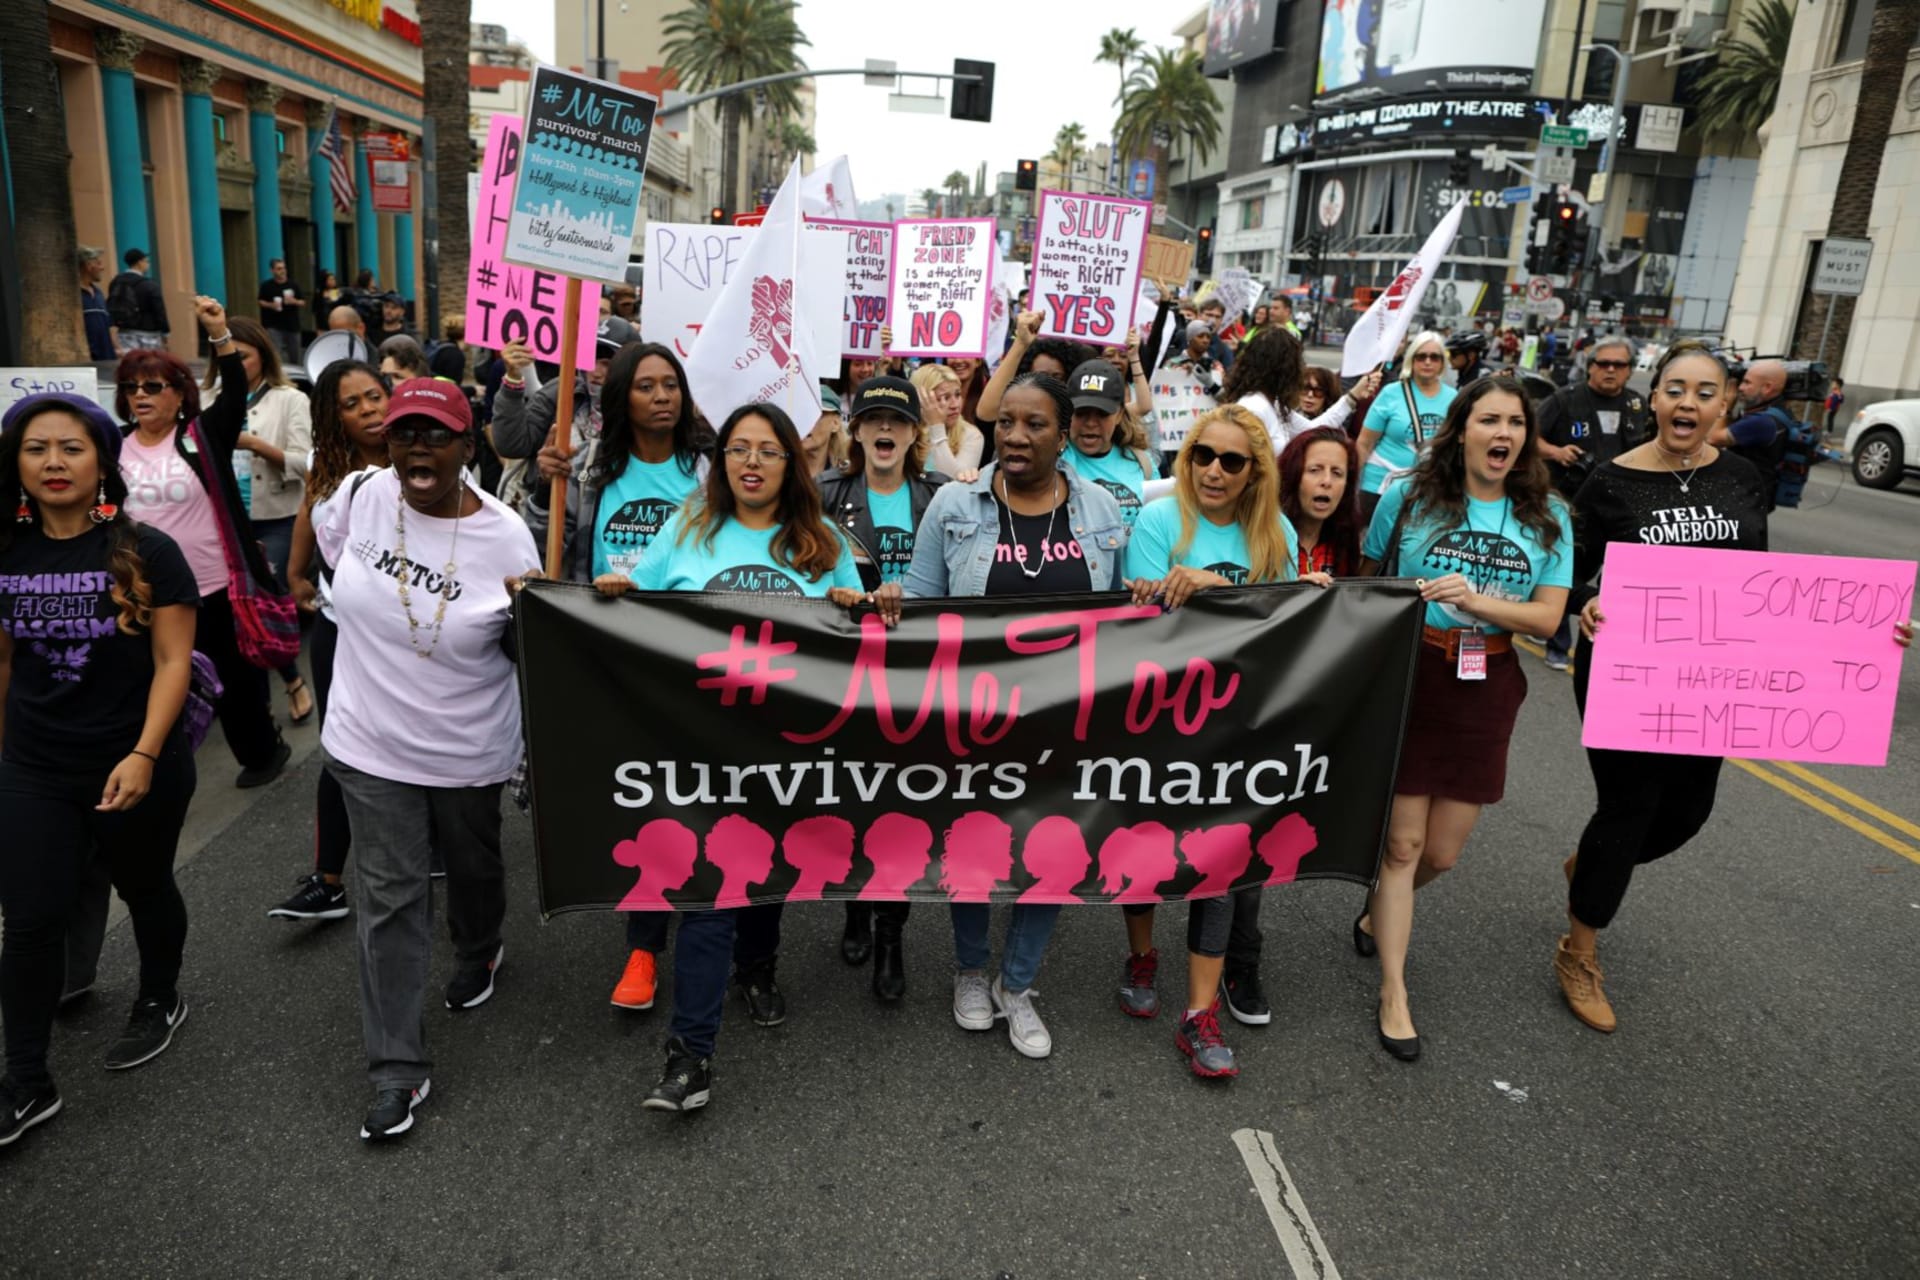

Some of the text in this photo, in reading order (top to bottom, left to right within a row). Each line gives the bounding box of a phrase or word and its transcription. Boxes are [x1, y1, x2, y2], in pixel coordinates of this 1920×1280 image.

[1396, 100, 1526, 119] DOLBY THEATRE
[602, 134, 642, 154] march
[528, 169, 579, 198] Hollywood
[1042, 253, 1113, 267] women for
[1058, 239, 1129, 263] attacking
[860, 269, 887, 281] their
[927, 266, 982, 283] attacking
[1039, 263, 1126, 286] their RIGHT
[1827, 261, 1861, 272] MUST
[903, 278, 968, 290] women for
[906, 287, 976, 301] their RIGHT
[1056, 281, 1101, 298] to say
[853, 295, 887, 322] YOU
[908, 301, 955, 311] to say
[1045, 293, 1115, 337] YES
[476, 299, 559, 356] TOO
[850, 322, 878, 349] IT
[910, 310, 963, 348] NO
[1080, 374, 1108, 392] CAT
[1652, 505, 1723, 524] TELL
[1639, 519, 1740, 545] SOMEBODY
[1040, 537, 1083, 563] too
[13, 595, 99, 618] FIGHT
[1622, 569, 1913, 646] TELL SOMEBODY
[1612, 660, 1882, 693] IT HAPPENED TO
[1639, 702, 1846, 753] #METOO
[613, 743, 1330, 809] survivors' march
